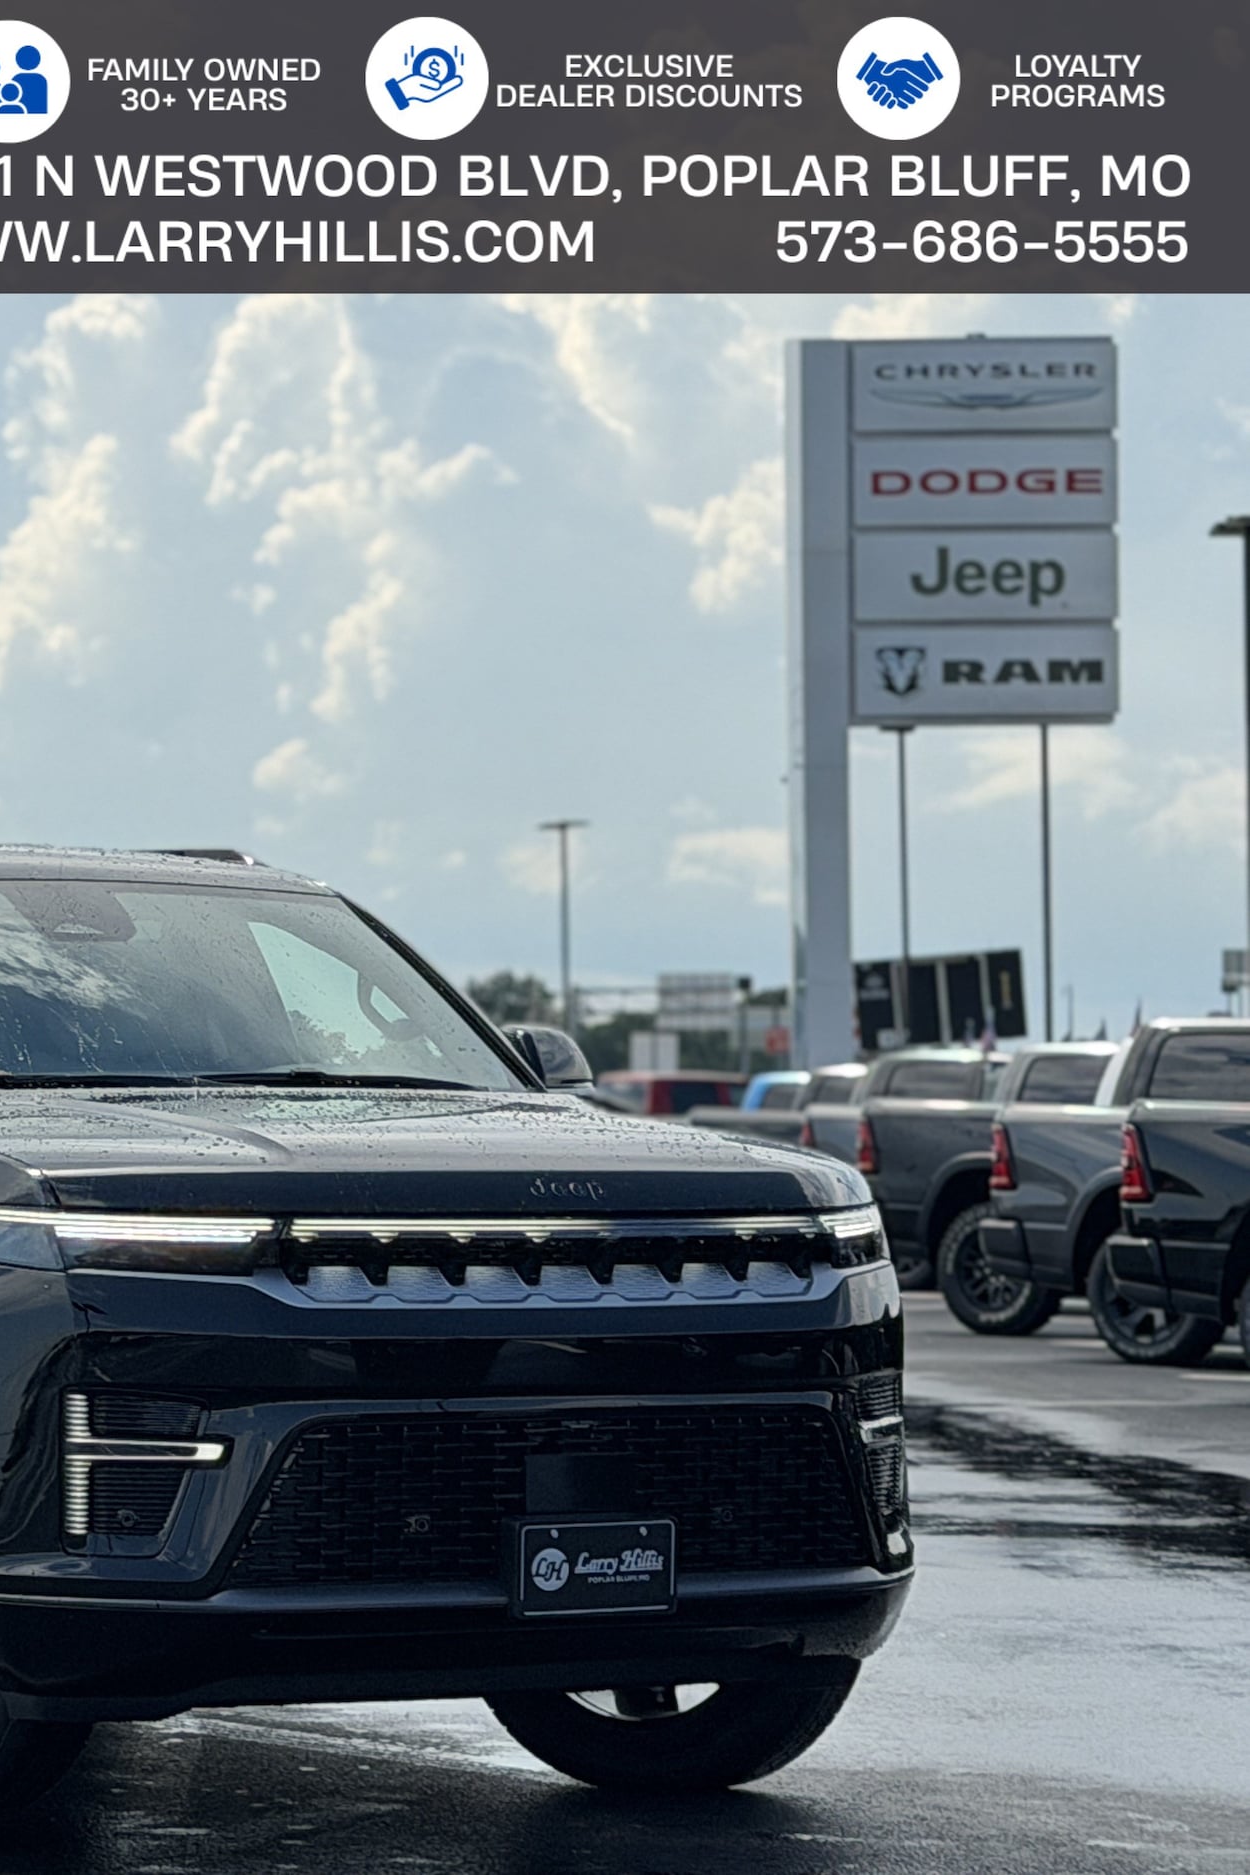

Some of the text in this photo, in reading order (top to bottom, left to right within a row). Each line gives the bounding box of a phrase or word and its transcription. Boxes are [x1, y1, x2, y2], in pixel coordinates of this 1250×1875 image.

[873, 362, 1098, 381] CHRYSLER
[870, 469, 1104, 496] DODGE
[909, 546, 1066, 607] Jeep
[942, 659, 1104, 685] RAM
[530, 1177, 605, 1201] Jeep
[574, 1548, 664, 1576] Larry Hillis
